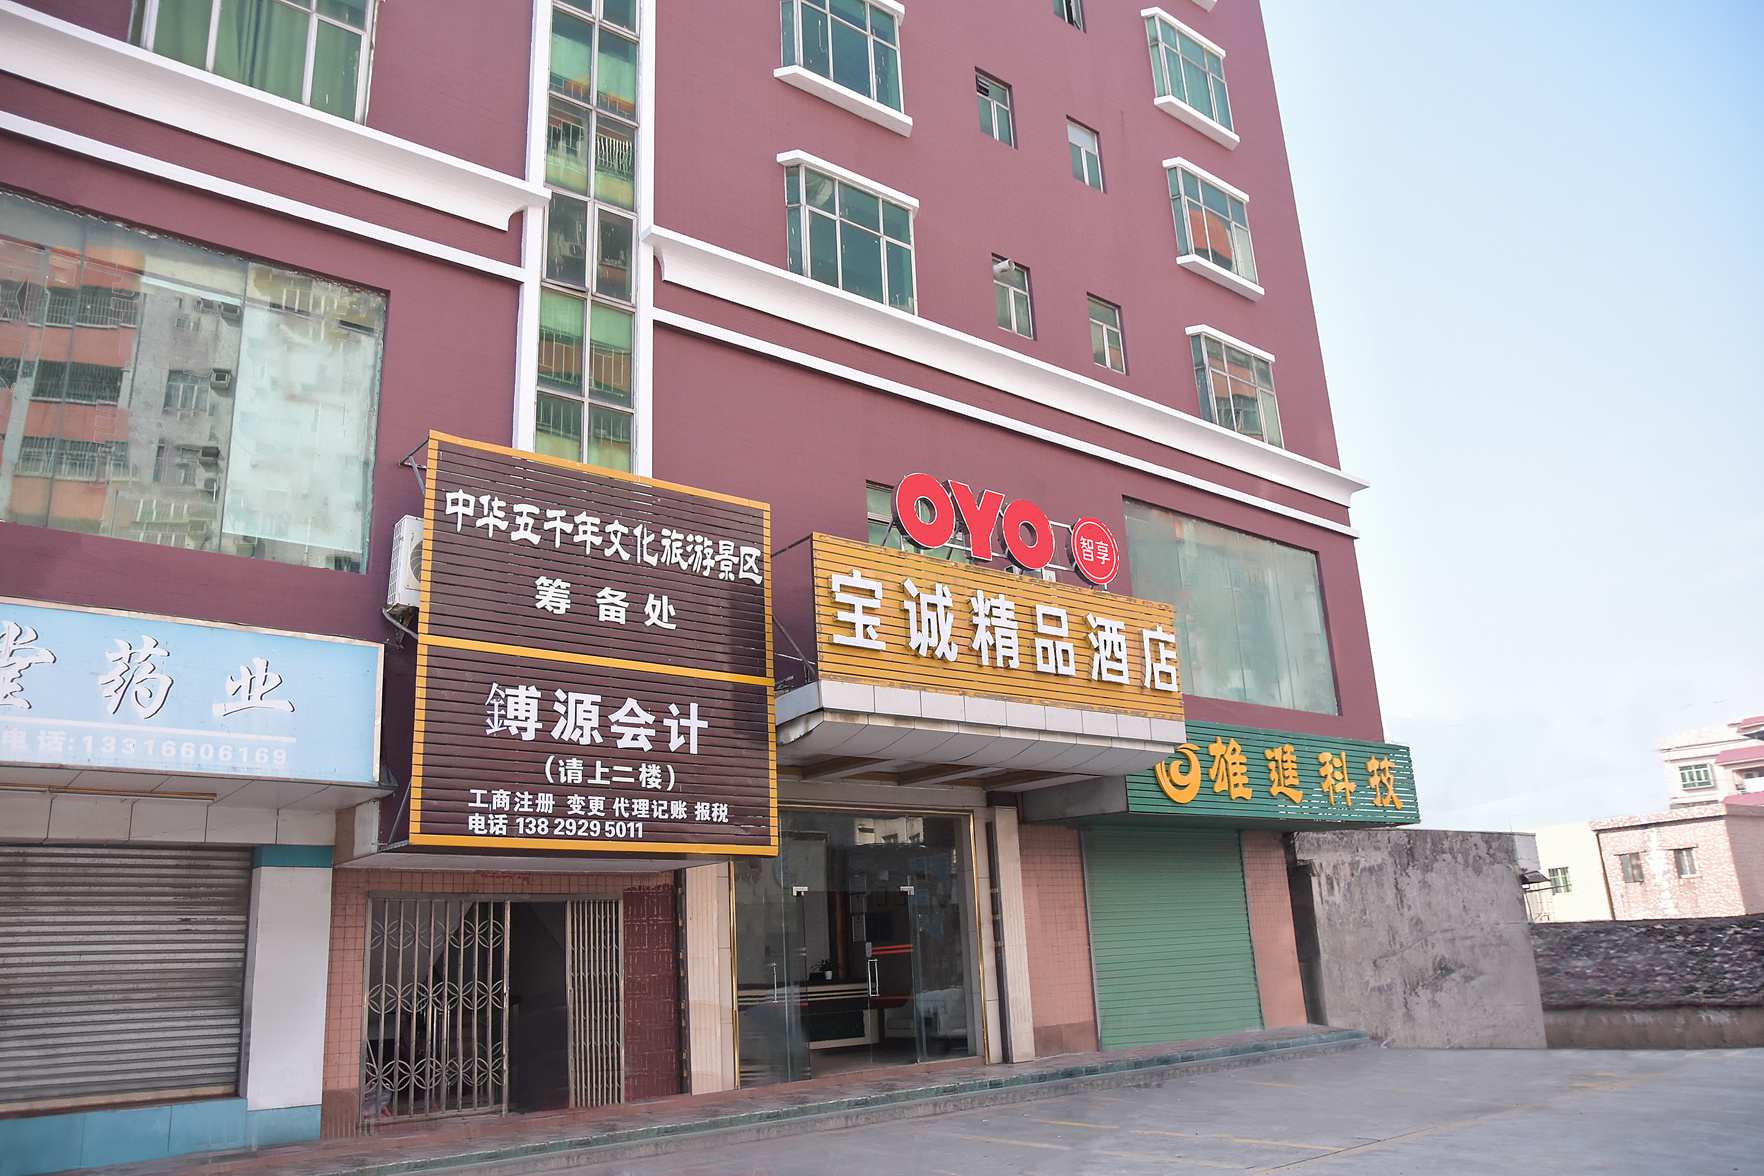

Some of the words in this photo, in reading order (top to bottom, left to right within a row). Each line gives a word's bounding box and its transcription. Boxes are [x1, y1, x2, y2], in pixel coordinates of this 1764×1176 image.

[445, 489, 763, 585] 中华五千年文化旅游景区
[893, 472, 1055, 570] OYO
[1080, 535, 1111, 565] 智享
[534, 575, 677, 630] 筹备处
[829, 568, 1178, 693] 宝诚精品酒店
[468, 789, 556, 814] 工商注册
[566, 793, 606, 818] 变更
[612, 796, 688, 822] 代理记账
[694, 801, 729, 824] 报税
[468, 812, 508, 836] 电话
[515, 816, 549, 836] 138
[553, 818, 601, 838] 2929
[604, 820, 644, 839] 5011
